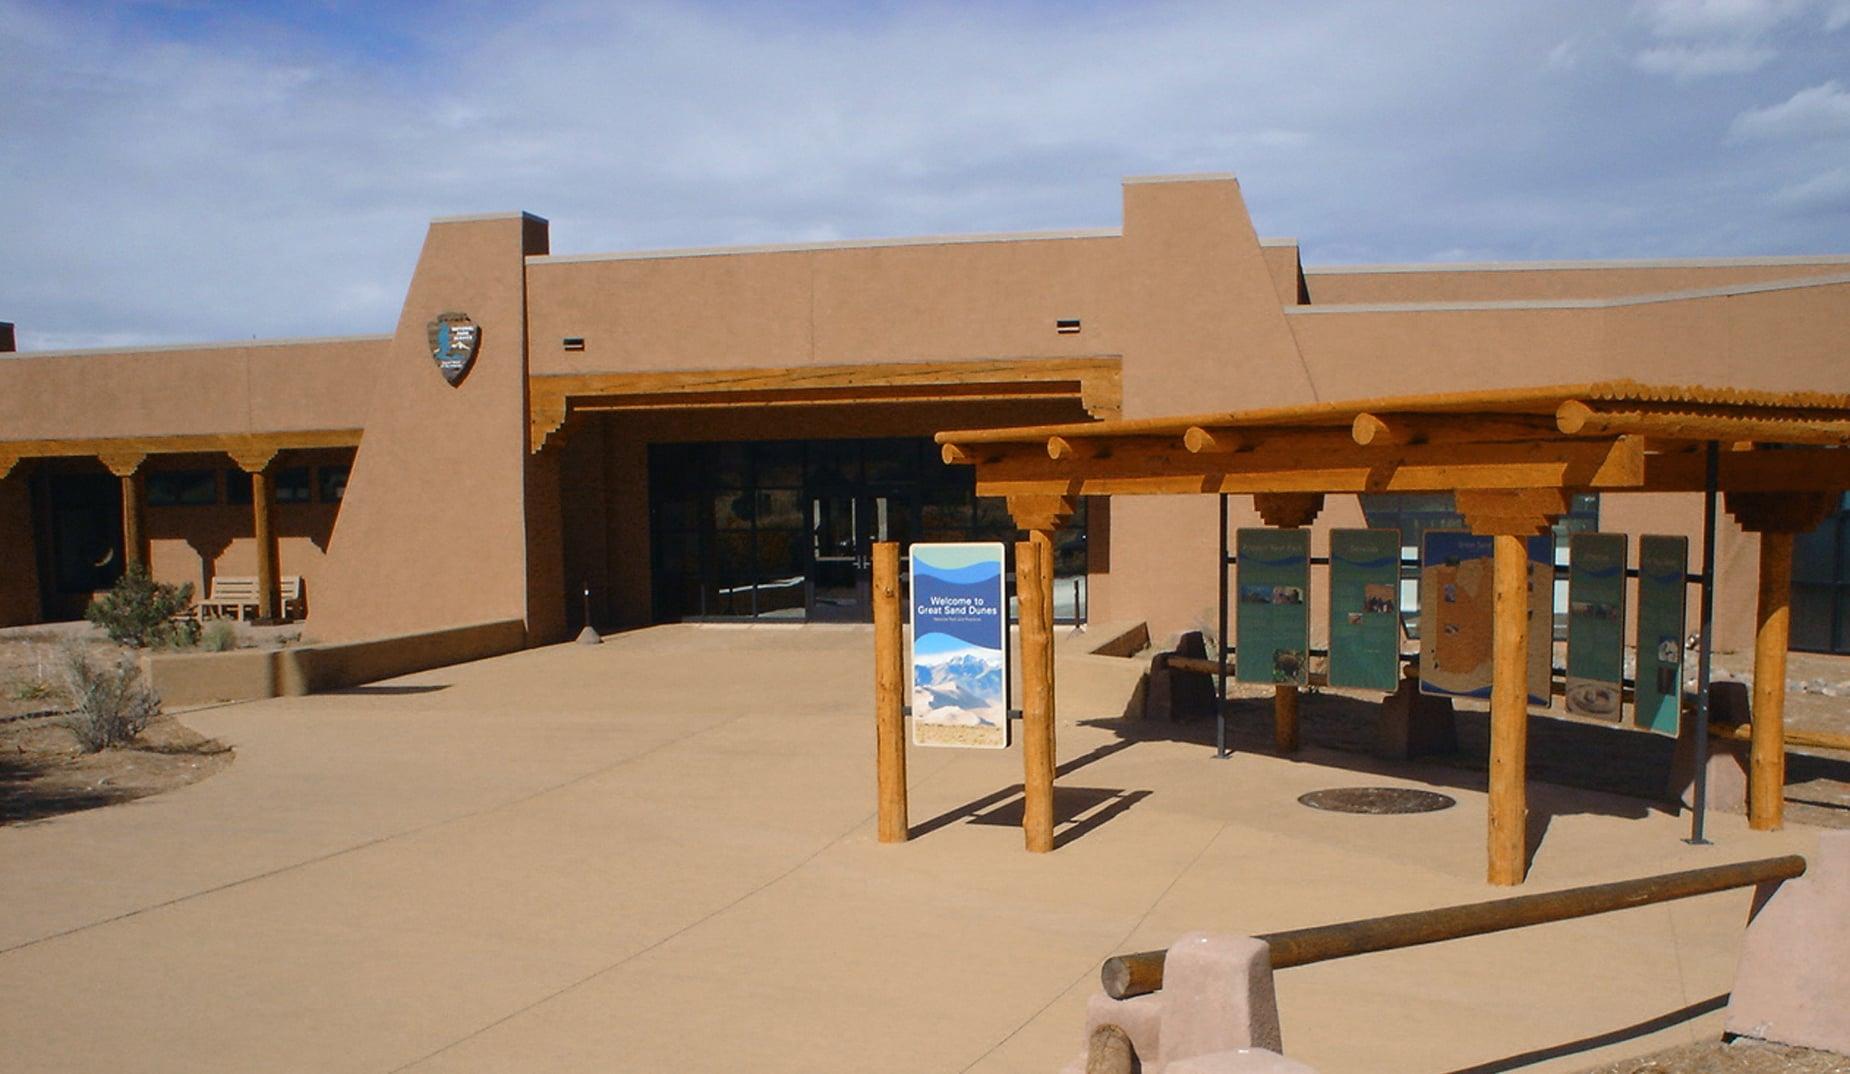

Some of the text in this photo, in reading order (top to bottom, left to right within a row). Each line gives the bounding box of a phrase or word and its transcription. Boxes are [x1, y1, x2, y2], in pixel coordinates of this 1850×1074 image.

[930, 596, 984, 606] Welcome to
[917, 605, 998, 615] Great Sand Dunes
